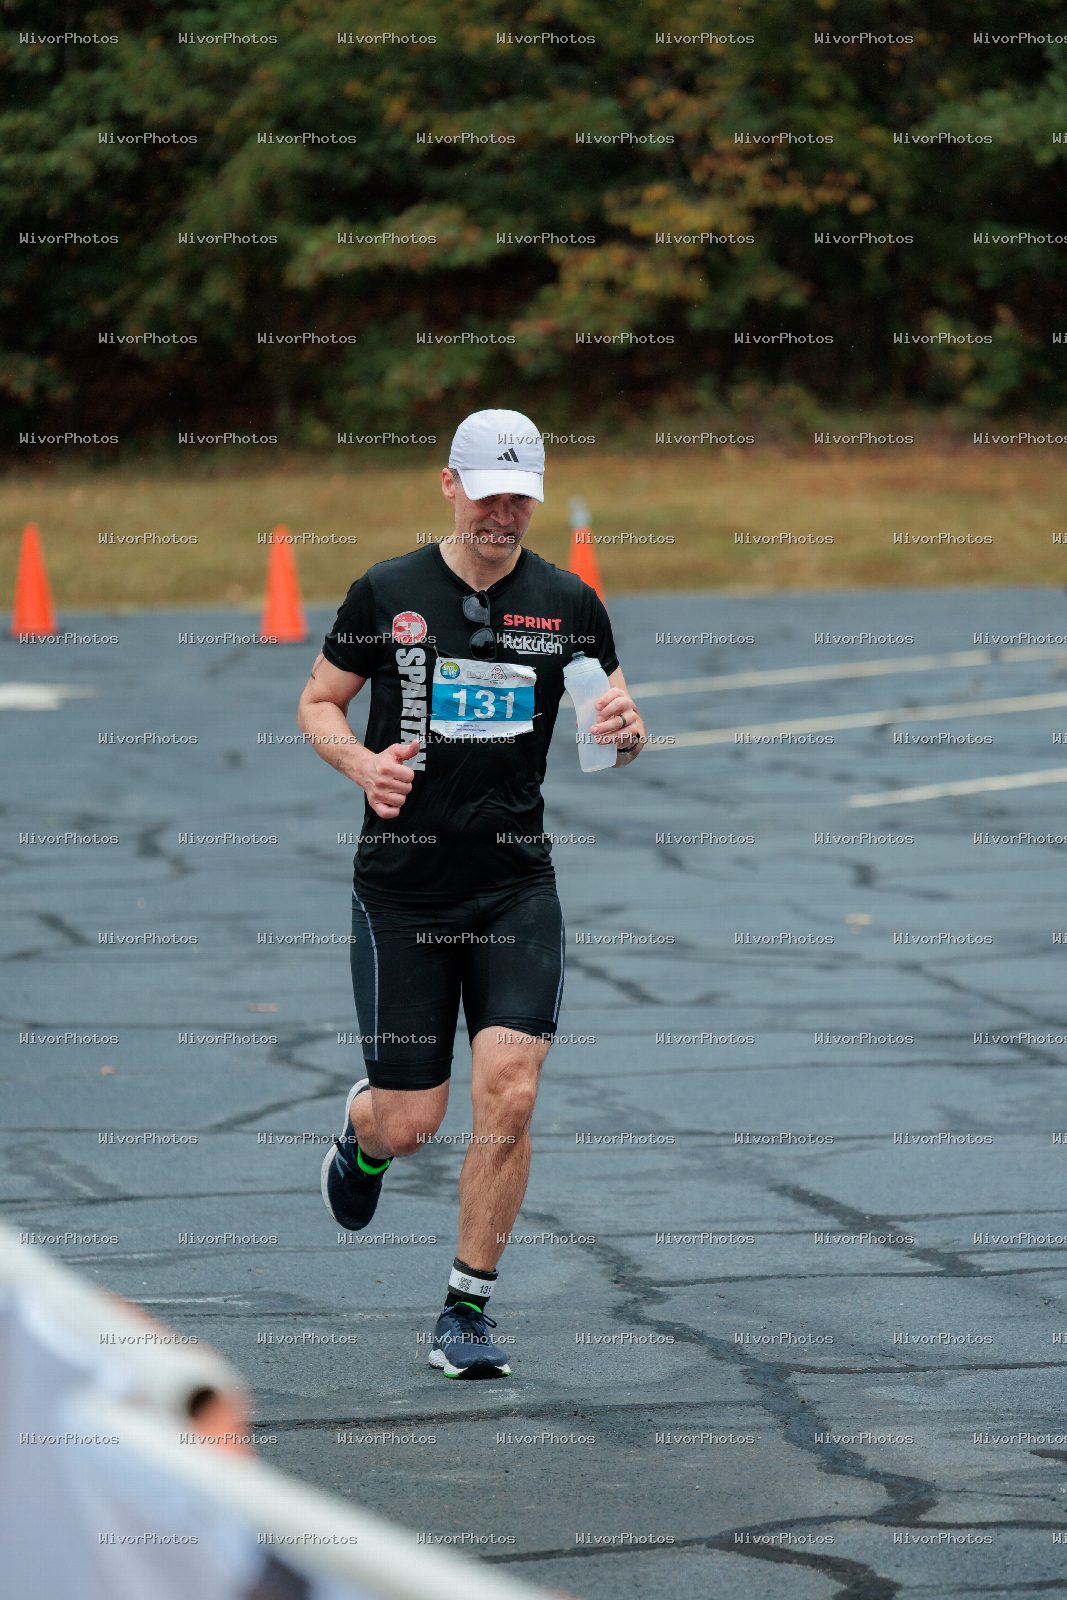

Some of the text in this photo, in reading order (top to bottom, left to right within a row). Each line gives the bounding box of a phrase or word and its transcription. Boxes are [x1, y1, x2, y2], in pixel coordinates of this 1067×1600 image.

[503, 614, 562, 631] SPRINT
[503, 634, 563, 655] Rakuten
[452, 688, 515, 719] 131
